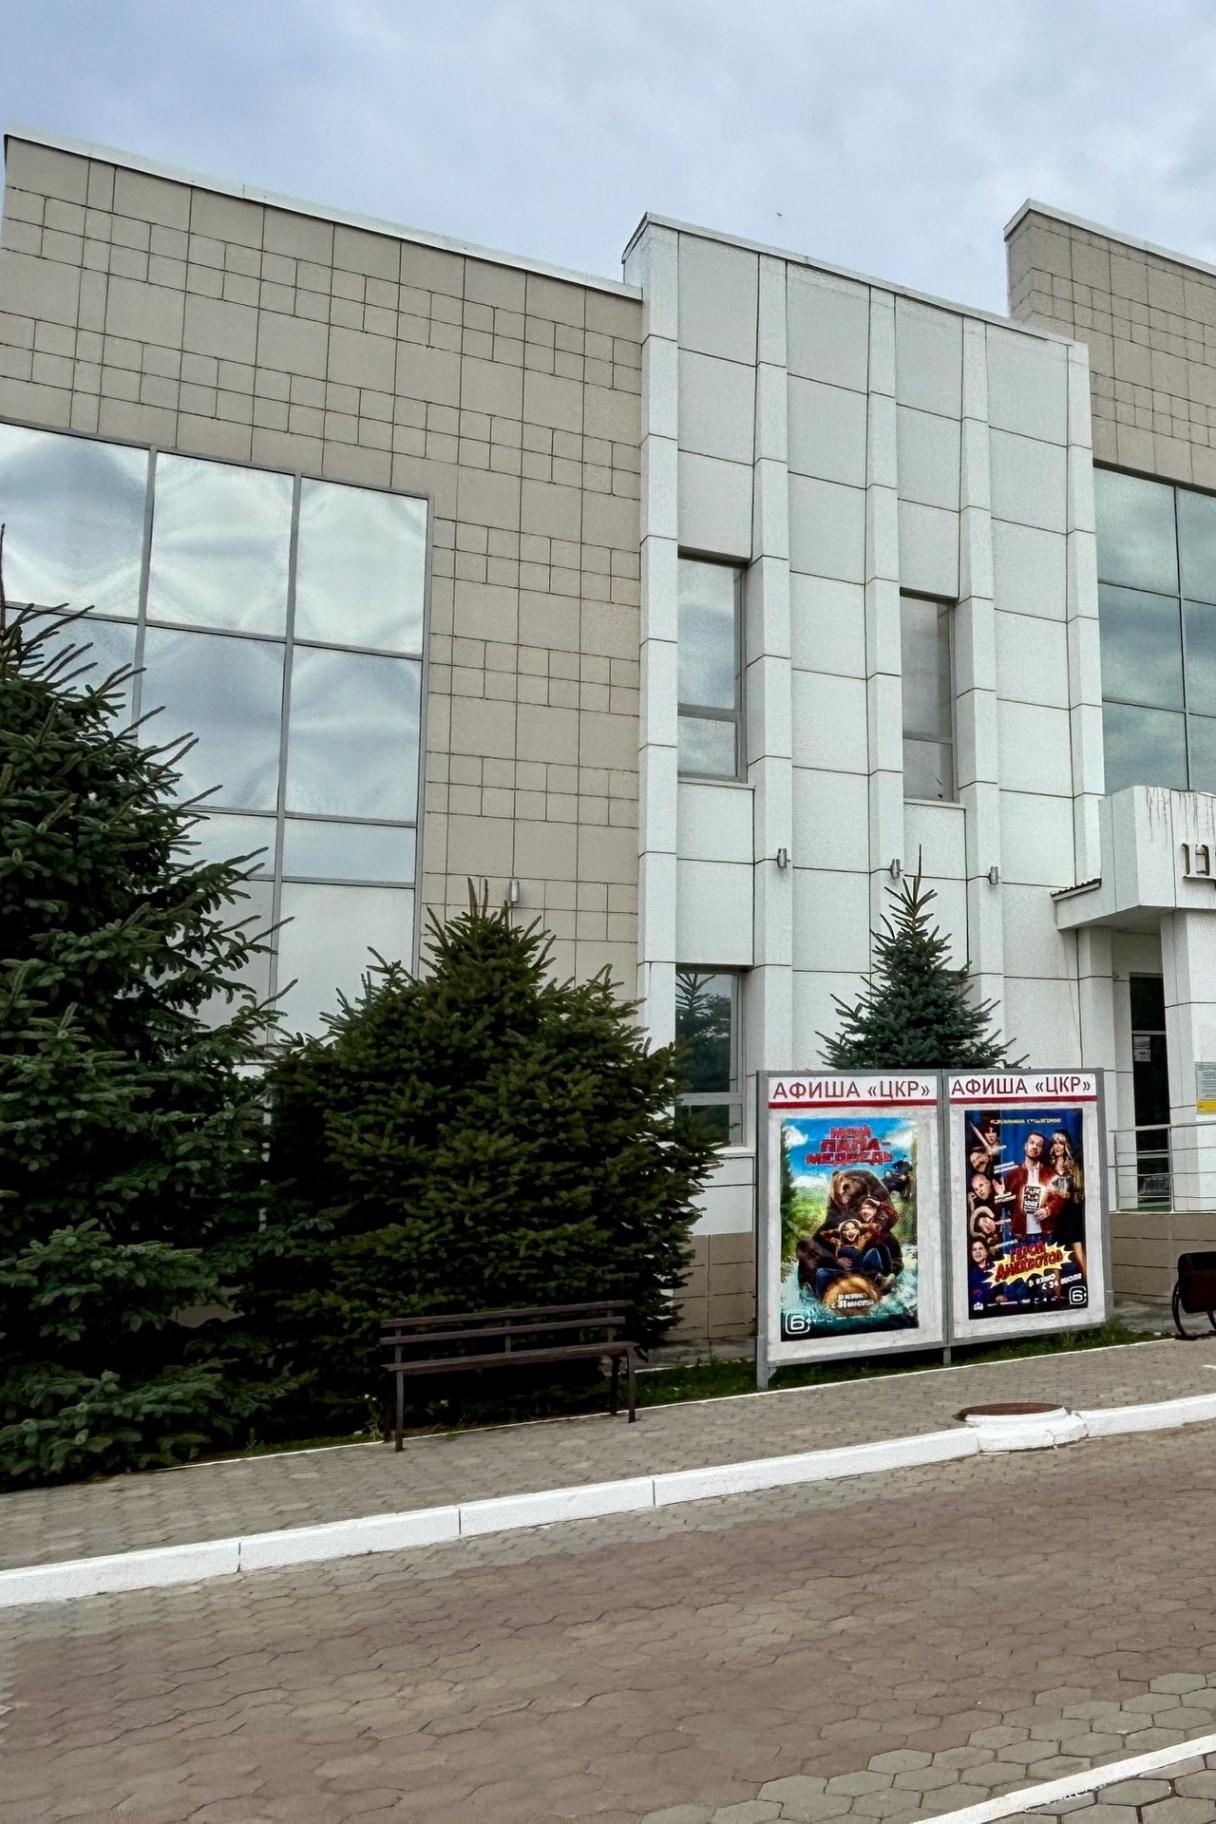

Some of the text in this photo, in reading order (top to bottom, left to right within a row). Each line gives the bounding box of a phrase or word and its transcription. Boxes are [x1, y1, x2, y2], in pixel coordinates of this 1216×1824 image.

[773, 1079, 930, 1100] АФИША «ЦКР»
[951, 1075, 1091, 1096] АФИША «ЦКР»
